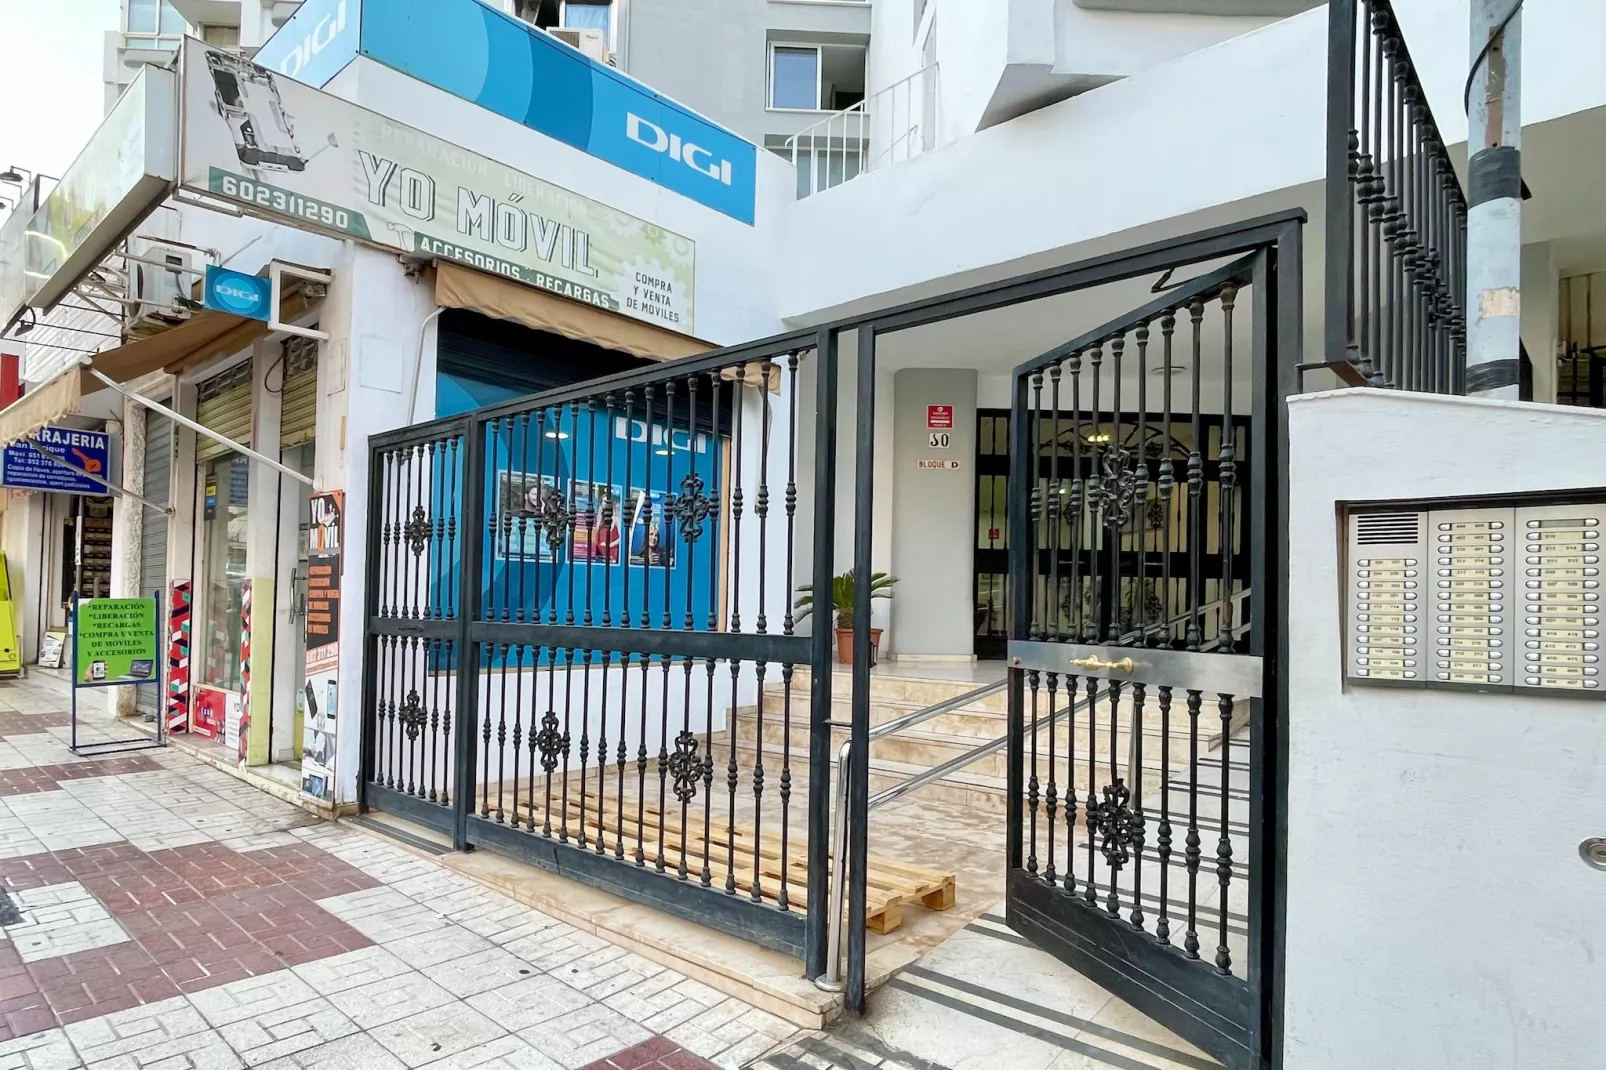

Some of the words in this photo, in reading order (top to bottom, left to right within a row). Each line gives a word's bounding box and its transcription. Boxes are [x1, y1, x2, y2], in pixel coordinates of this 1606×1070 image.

[281, 0, 346, 77] DIGI
[626, 111, 732, 186] DIGI
[222, 175, 348, 229] 602311290
[358, 149, 436, 222] YO
[456, 186, 599, 278] MÓVIL
[420, 237, 520, 279] ACCESORIOS
[536, 273, 610, 309] RECARGAS
[635, 271, 673, 294] COMPRA
[215, 284, 259, 302] DIGI
[633, 285, 640, 296] Y
[643, 288, 672, 307] VENTA
[626, 297, 638, 310] DE
[641, 301, 680, 323] MOVILES
[615, 416, 706, 454] DIGI
[311, 497, 325, 524] YO
[91, 640, 103, 648] DE
[95, 648, 147, 657] ACCESORIOS
